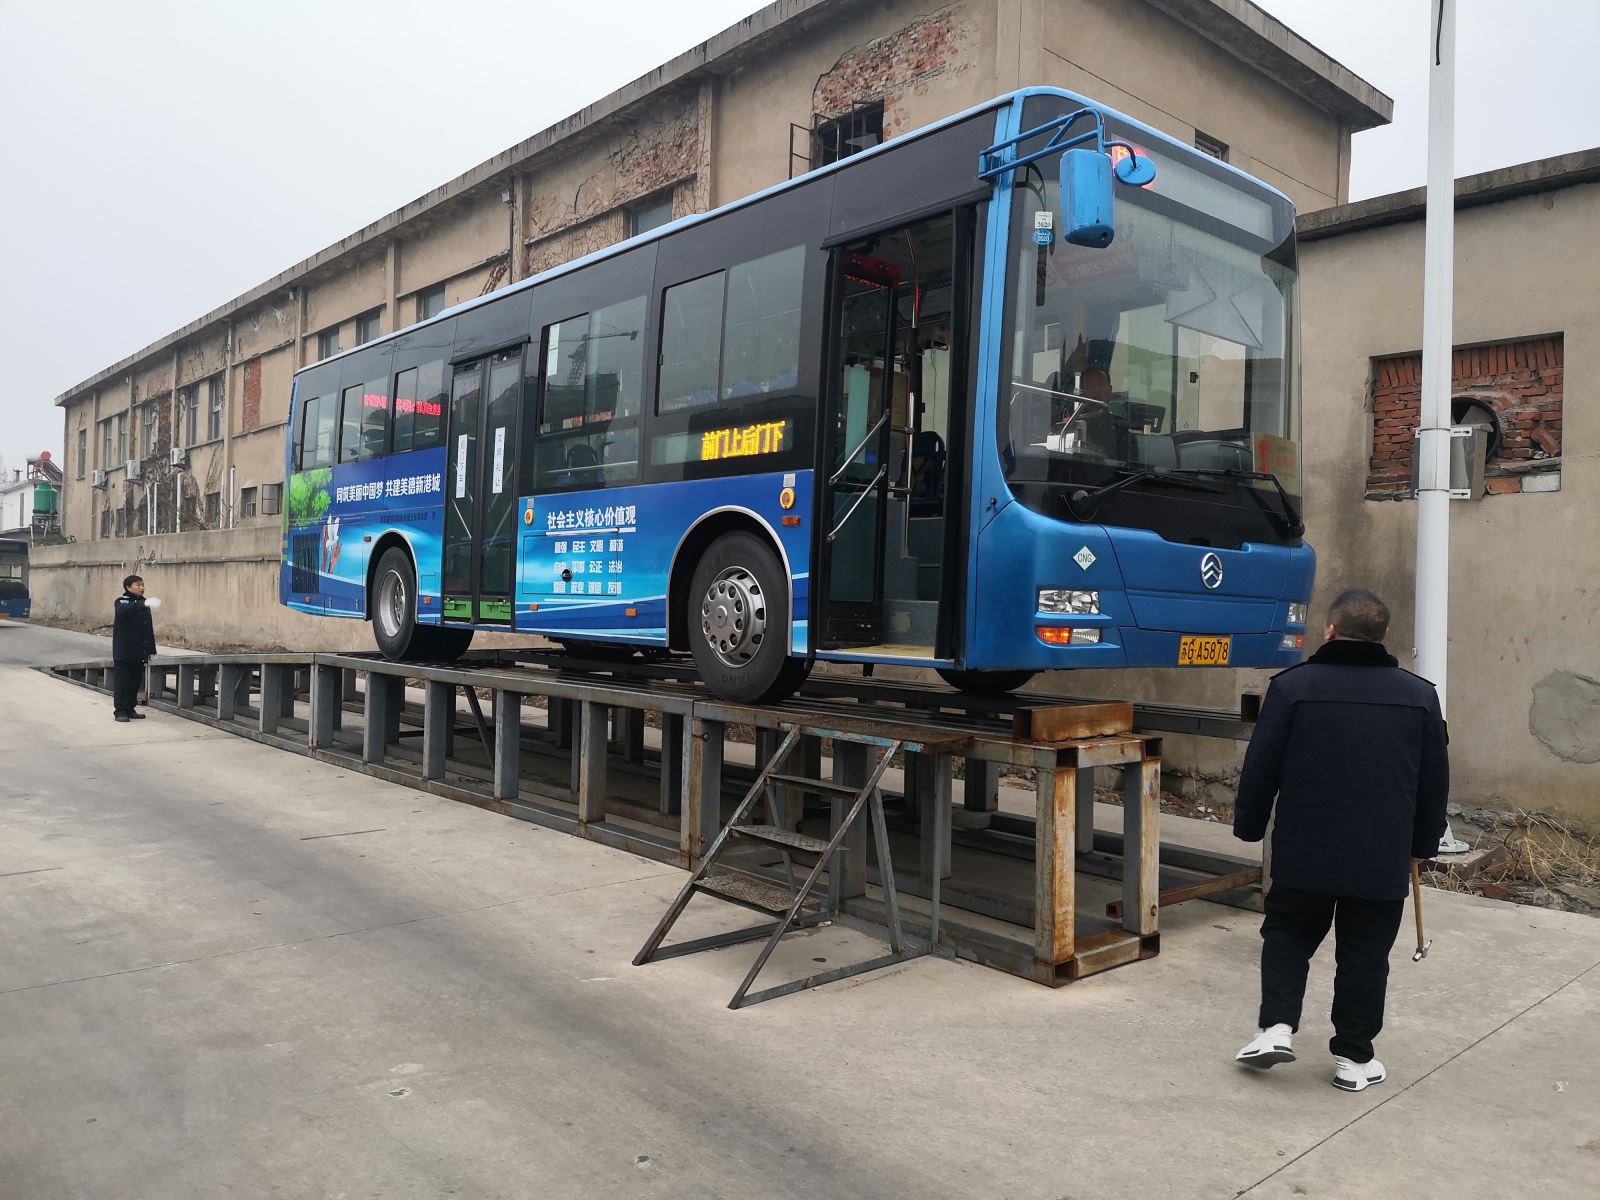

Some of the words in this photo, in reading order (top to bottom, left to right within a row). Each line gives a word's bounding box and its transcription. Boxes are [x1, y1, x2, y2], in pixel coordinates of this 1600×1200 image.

[701, 420, 786, 461] 前门上后门下
[336, 481, 384, 504] 同筑美丽中国梦
[547, 505, 636, 530] 社会主义核心价值观
[1077, 553, 1092, 564] CNG
